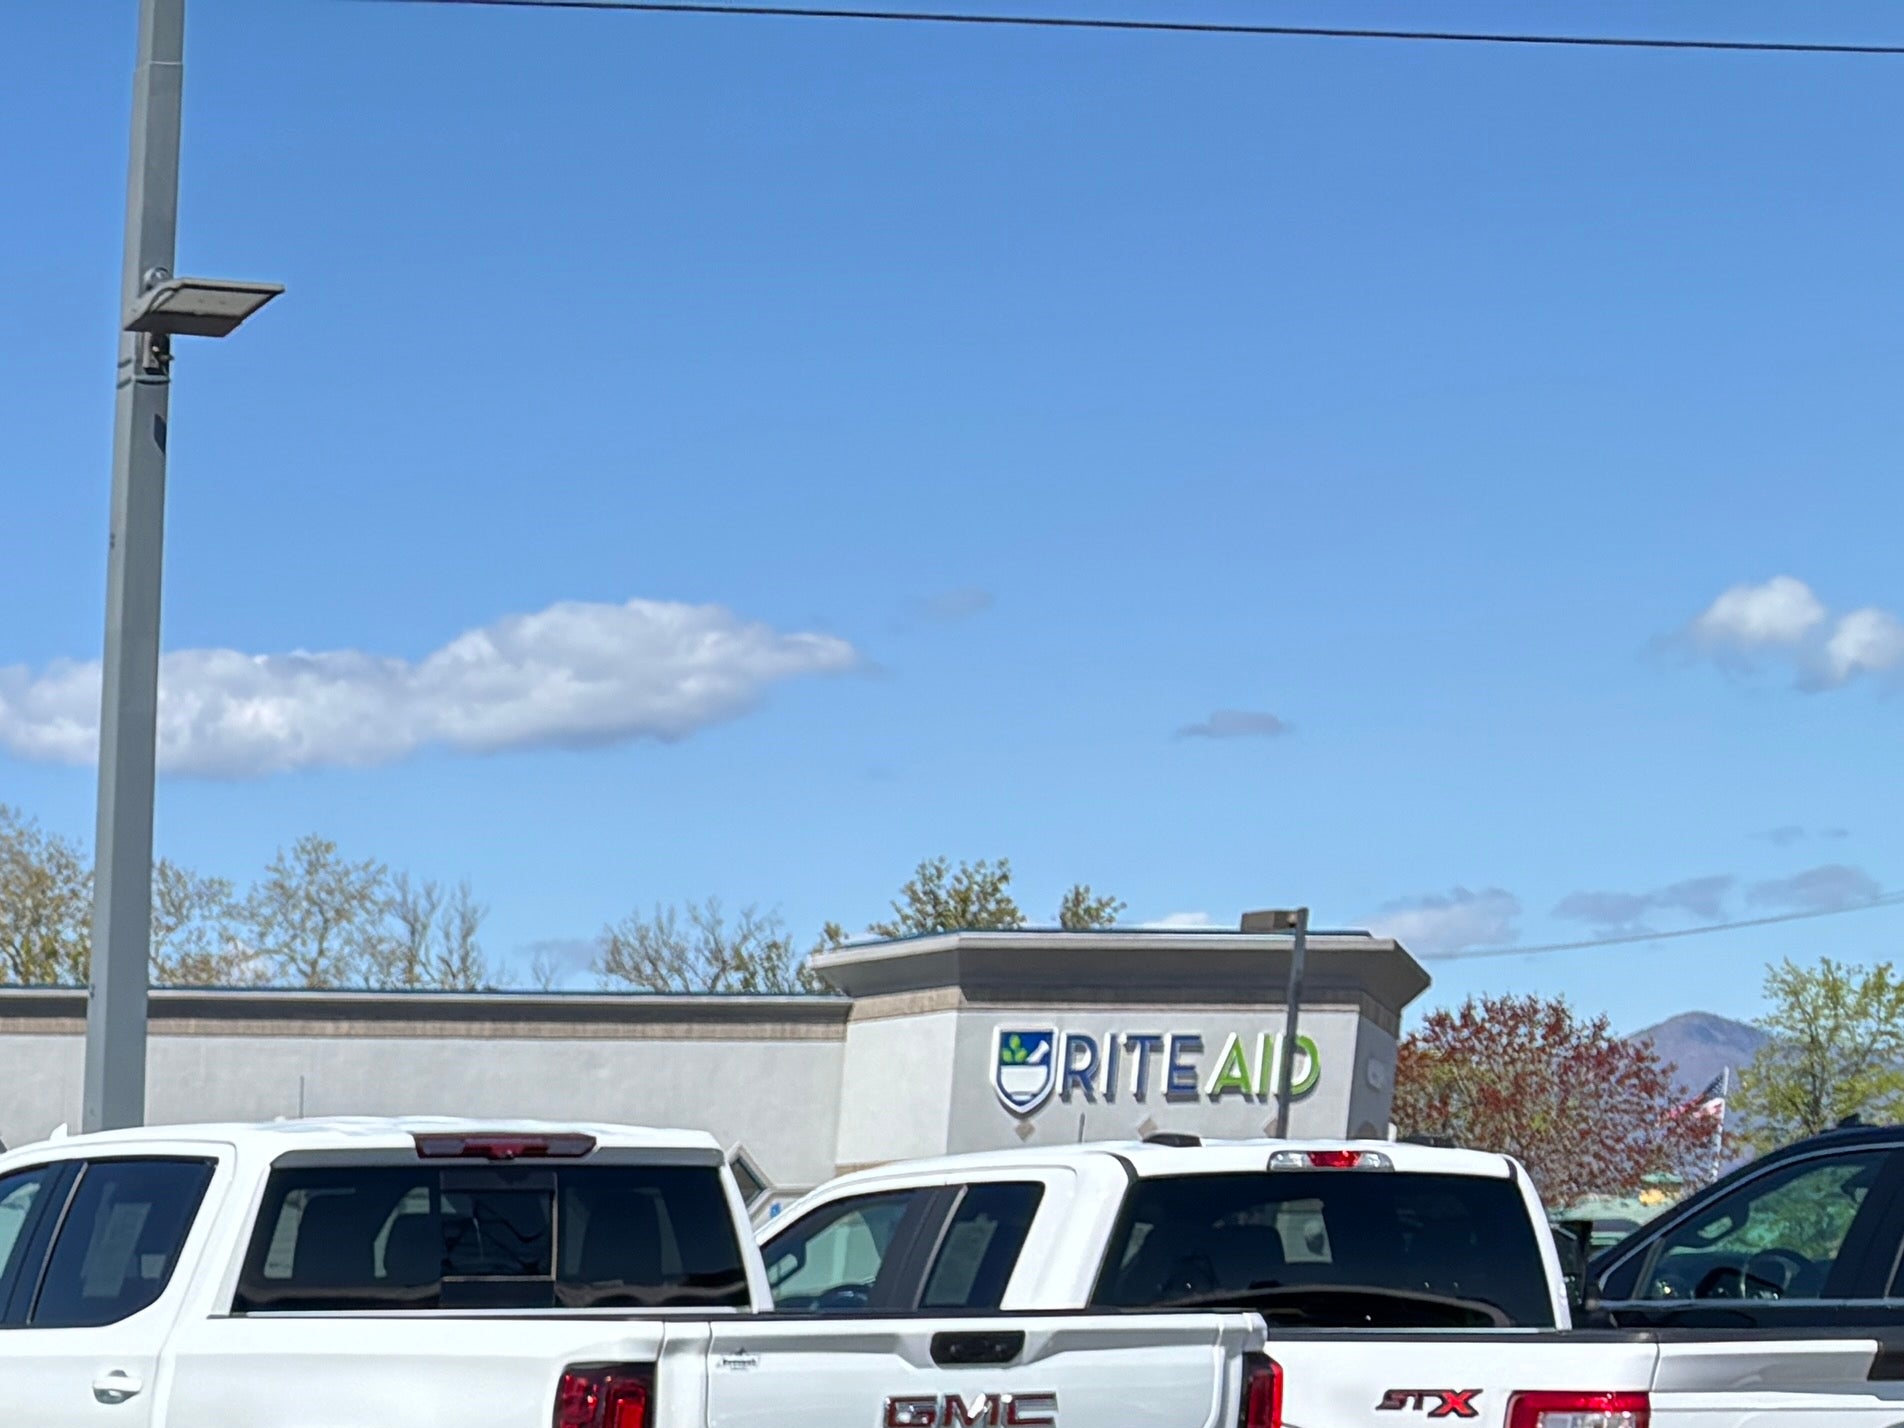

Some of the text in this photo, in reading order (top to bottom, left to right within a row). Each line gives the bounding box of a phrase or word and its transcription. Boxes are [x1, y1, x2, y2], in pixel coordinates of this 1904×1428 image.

[1055, 1031, 1321, 1101] RITE AID
[1375, 1388, 1483, 1418] STX
